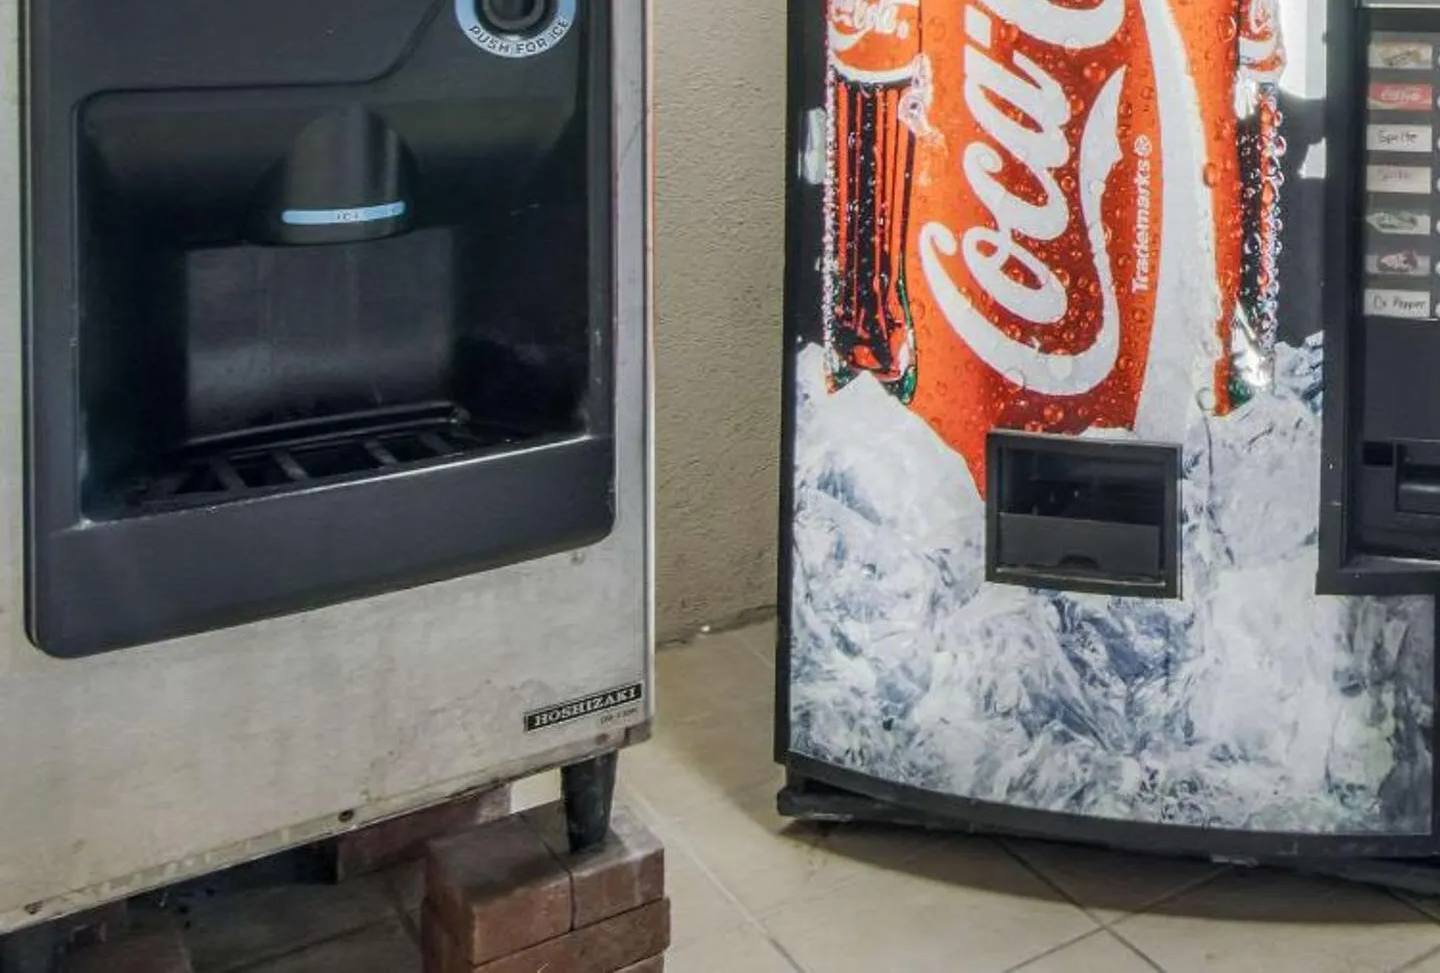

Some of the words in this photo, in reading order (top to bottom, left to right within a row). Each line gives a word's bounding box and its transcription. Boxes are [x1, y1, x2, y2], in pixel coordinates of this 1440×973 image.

[468, 25, 510, 53] PUSH
[515, 37, 548, 52] FOR
[549, 14, 569, 39] ICE
[535, 687, 637, 726] HOSHIZAKI
